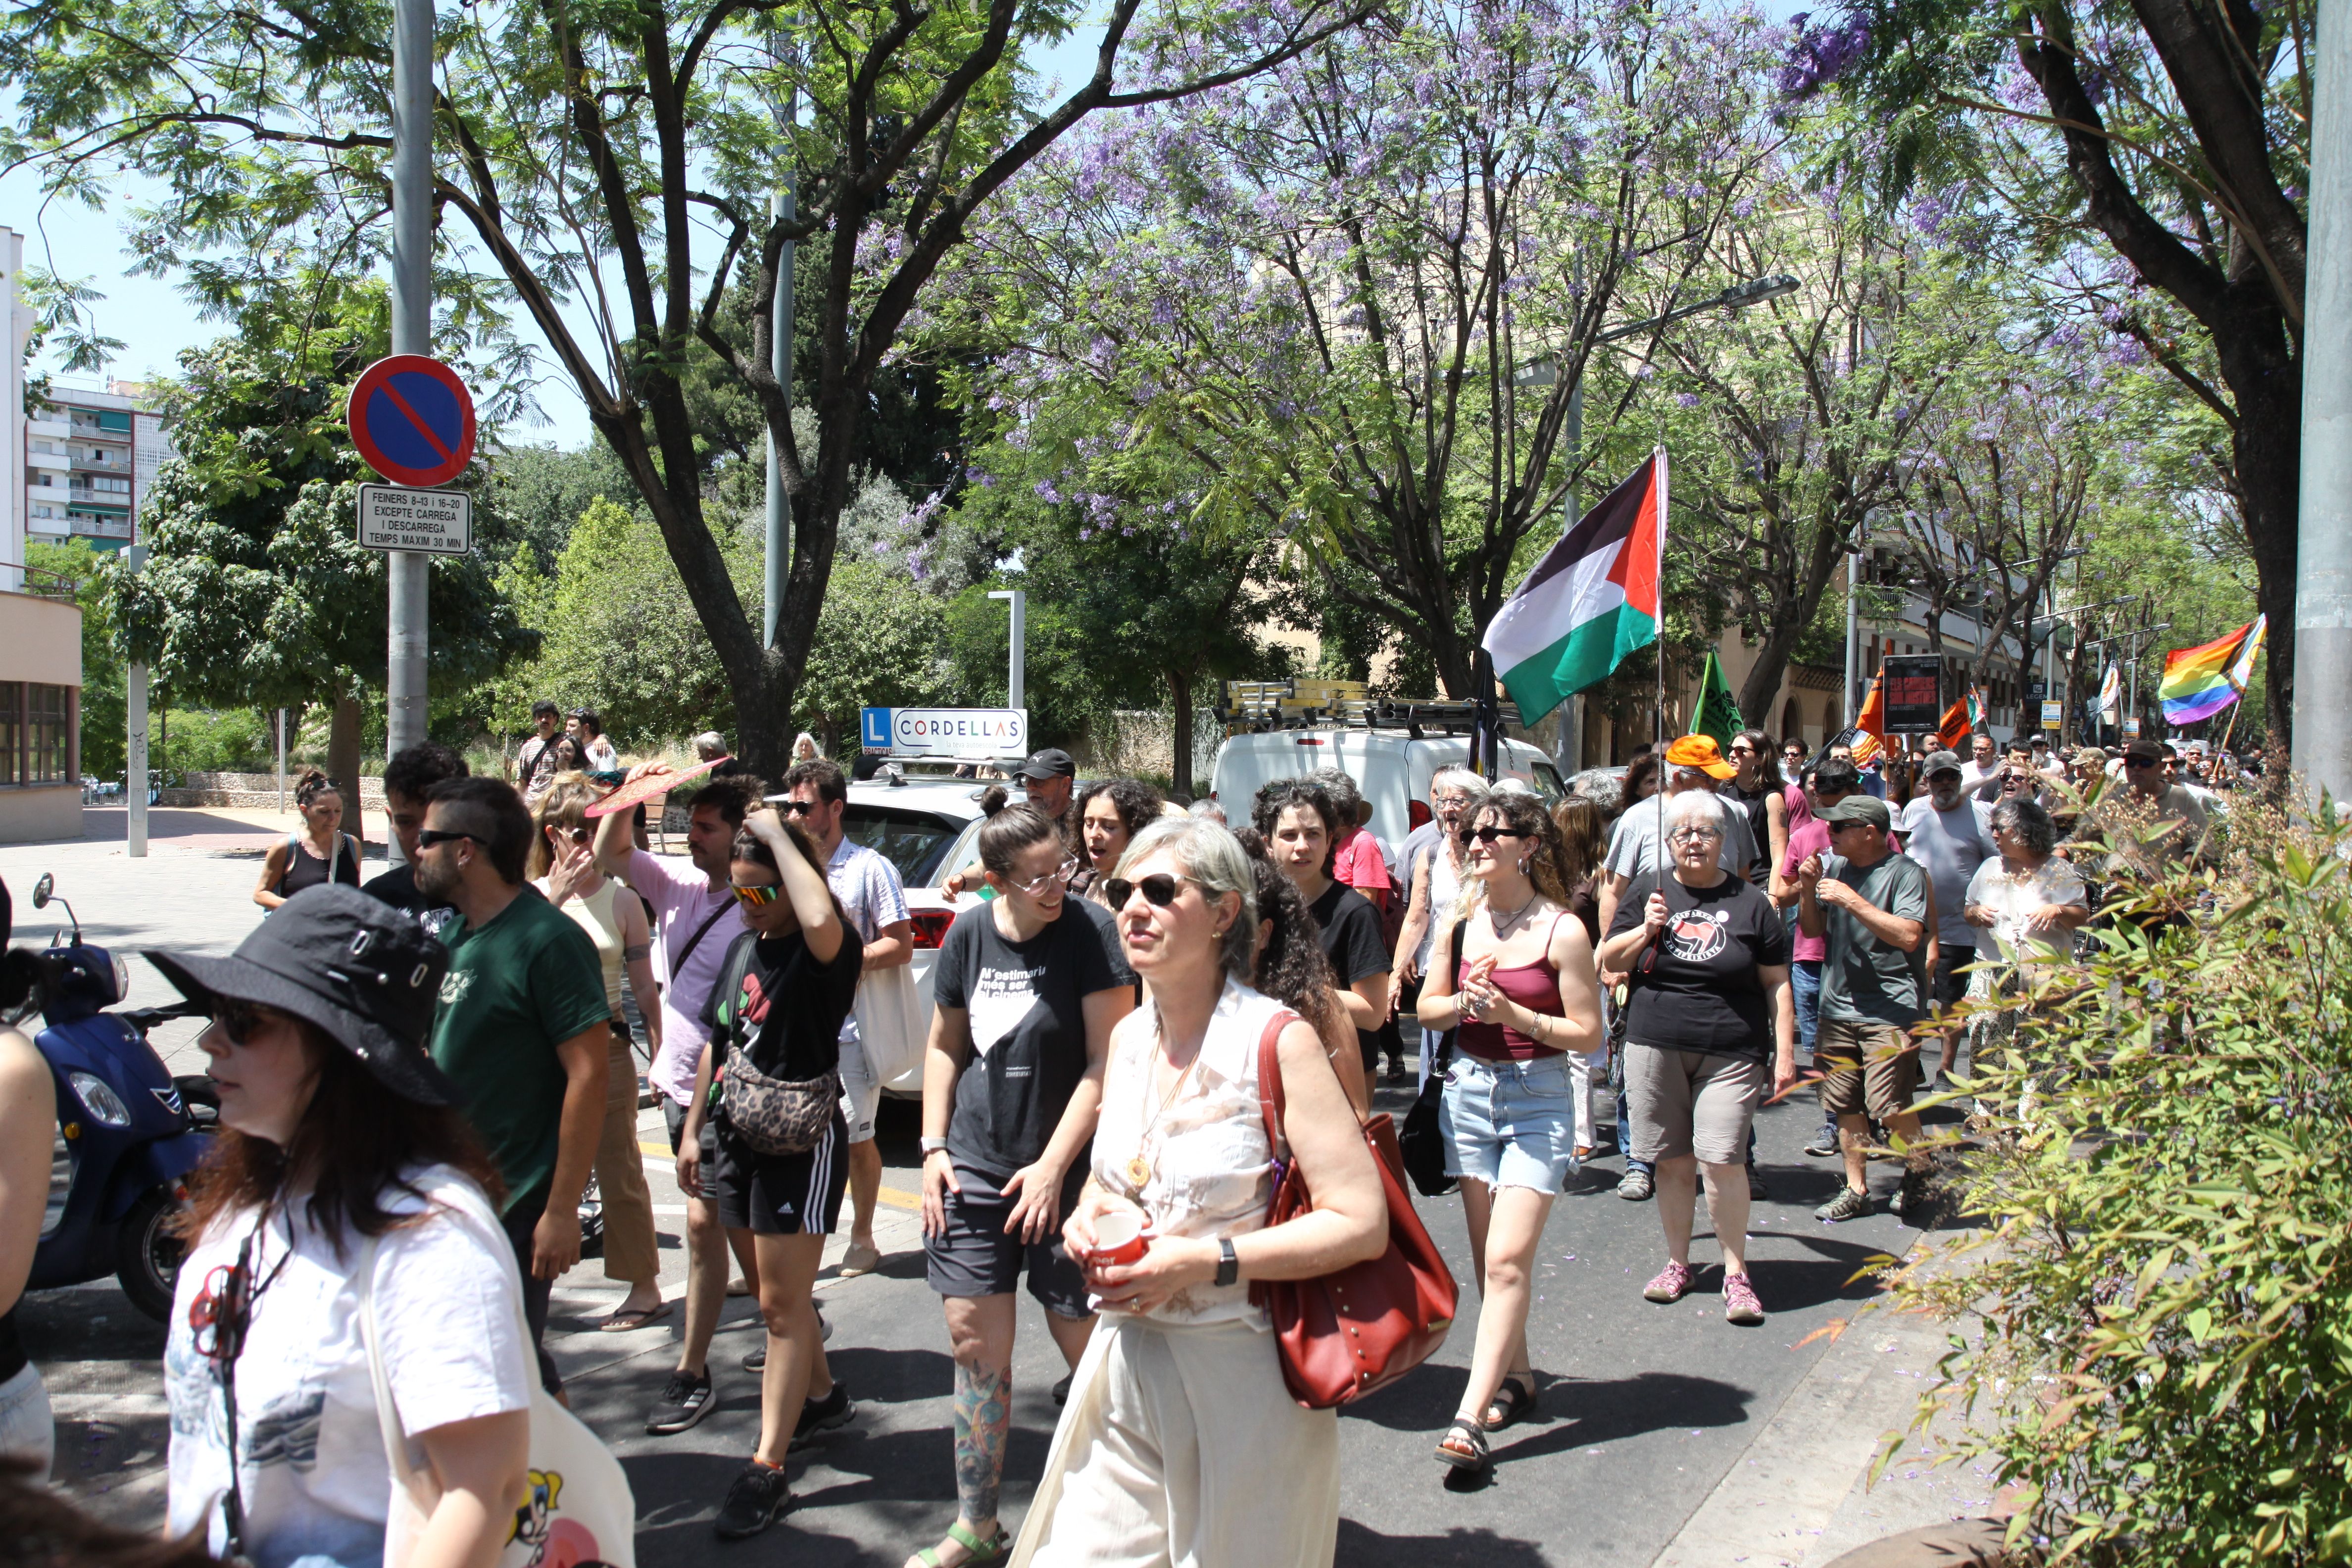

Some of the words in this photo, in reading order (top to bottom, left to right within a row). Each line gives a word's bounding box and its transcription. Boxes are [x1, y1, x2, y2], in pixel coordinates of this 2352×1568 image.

[373, 492, 407, 505] FEINERS
[411, 495, 428, 506] 8-13
[438, 498, 460, 509] 16-20
[375, 506, 412, 518] EXCEPTE
[416, 509, 457, 521] CARREGA
[382, 520, 385, 529] I
[389, 520, 445, 534] DESCARREGA
[370, 532, 398, 543] TEMPS
[402, 535, 430, 546] MAXIM
[434, 537, 443, 547] 30
[447, 539, 461, 548] MIN
[869, 713, 884, 741] L
[900, 720, 1018, 737] CORDELLAS
[1665, 940, 1721, 961] ANTIFEIXISTA
[980, 980, 1006, 990] més
[1009, 980, 1028, 990] ser
[980, 989, 989, 998] al
[991, 988, 1034, 999] cinema
